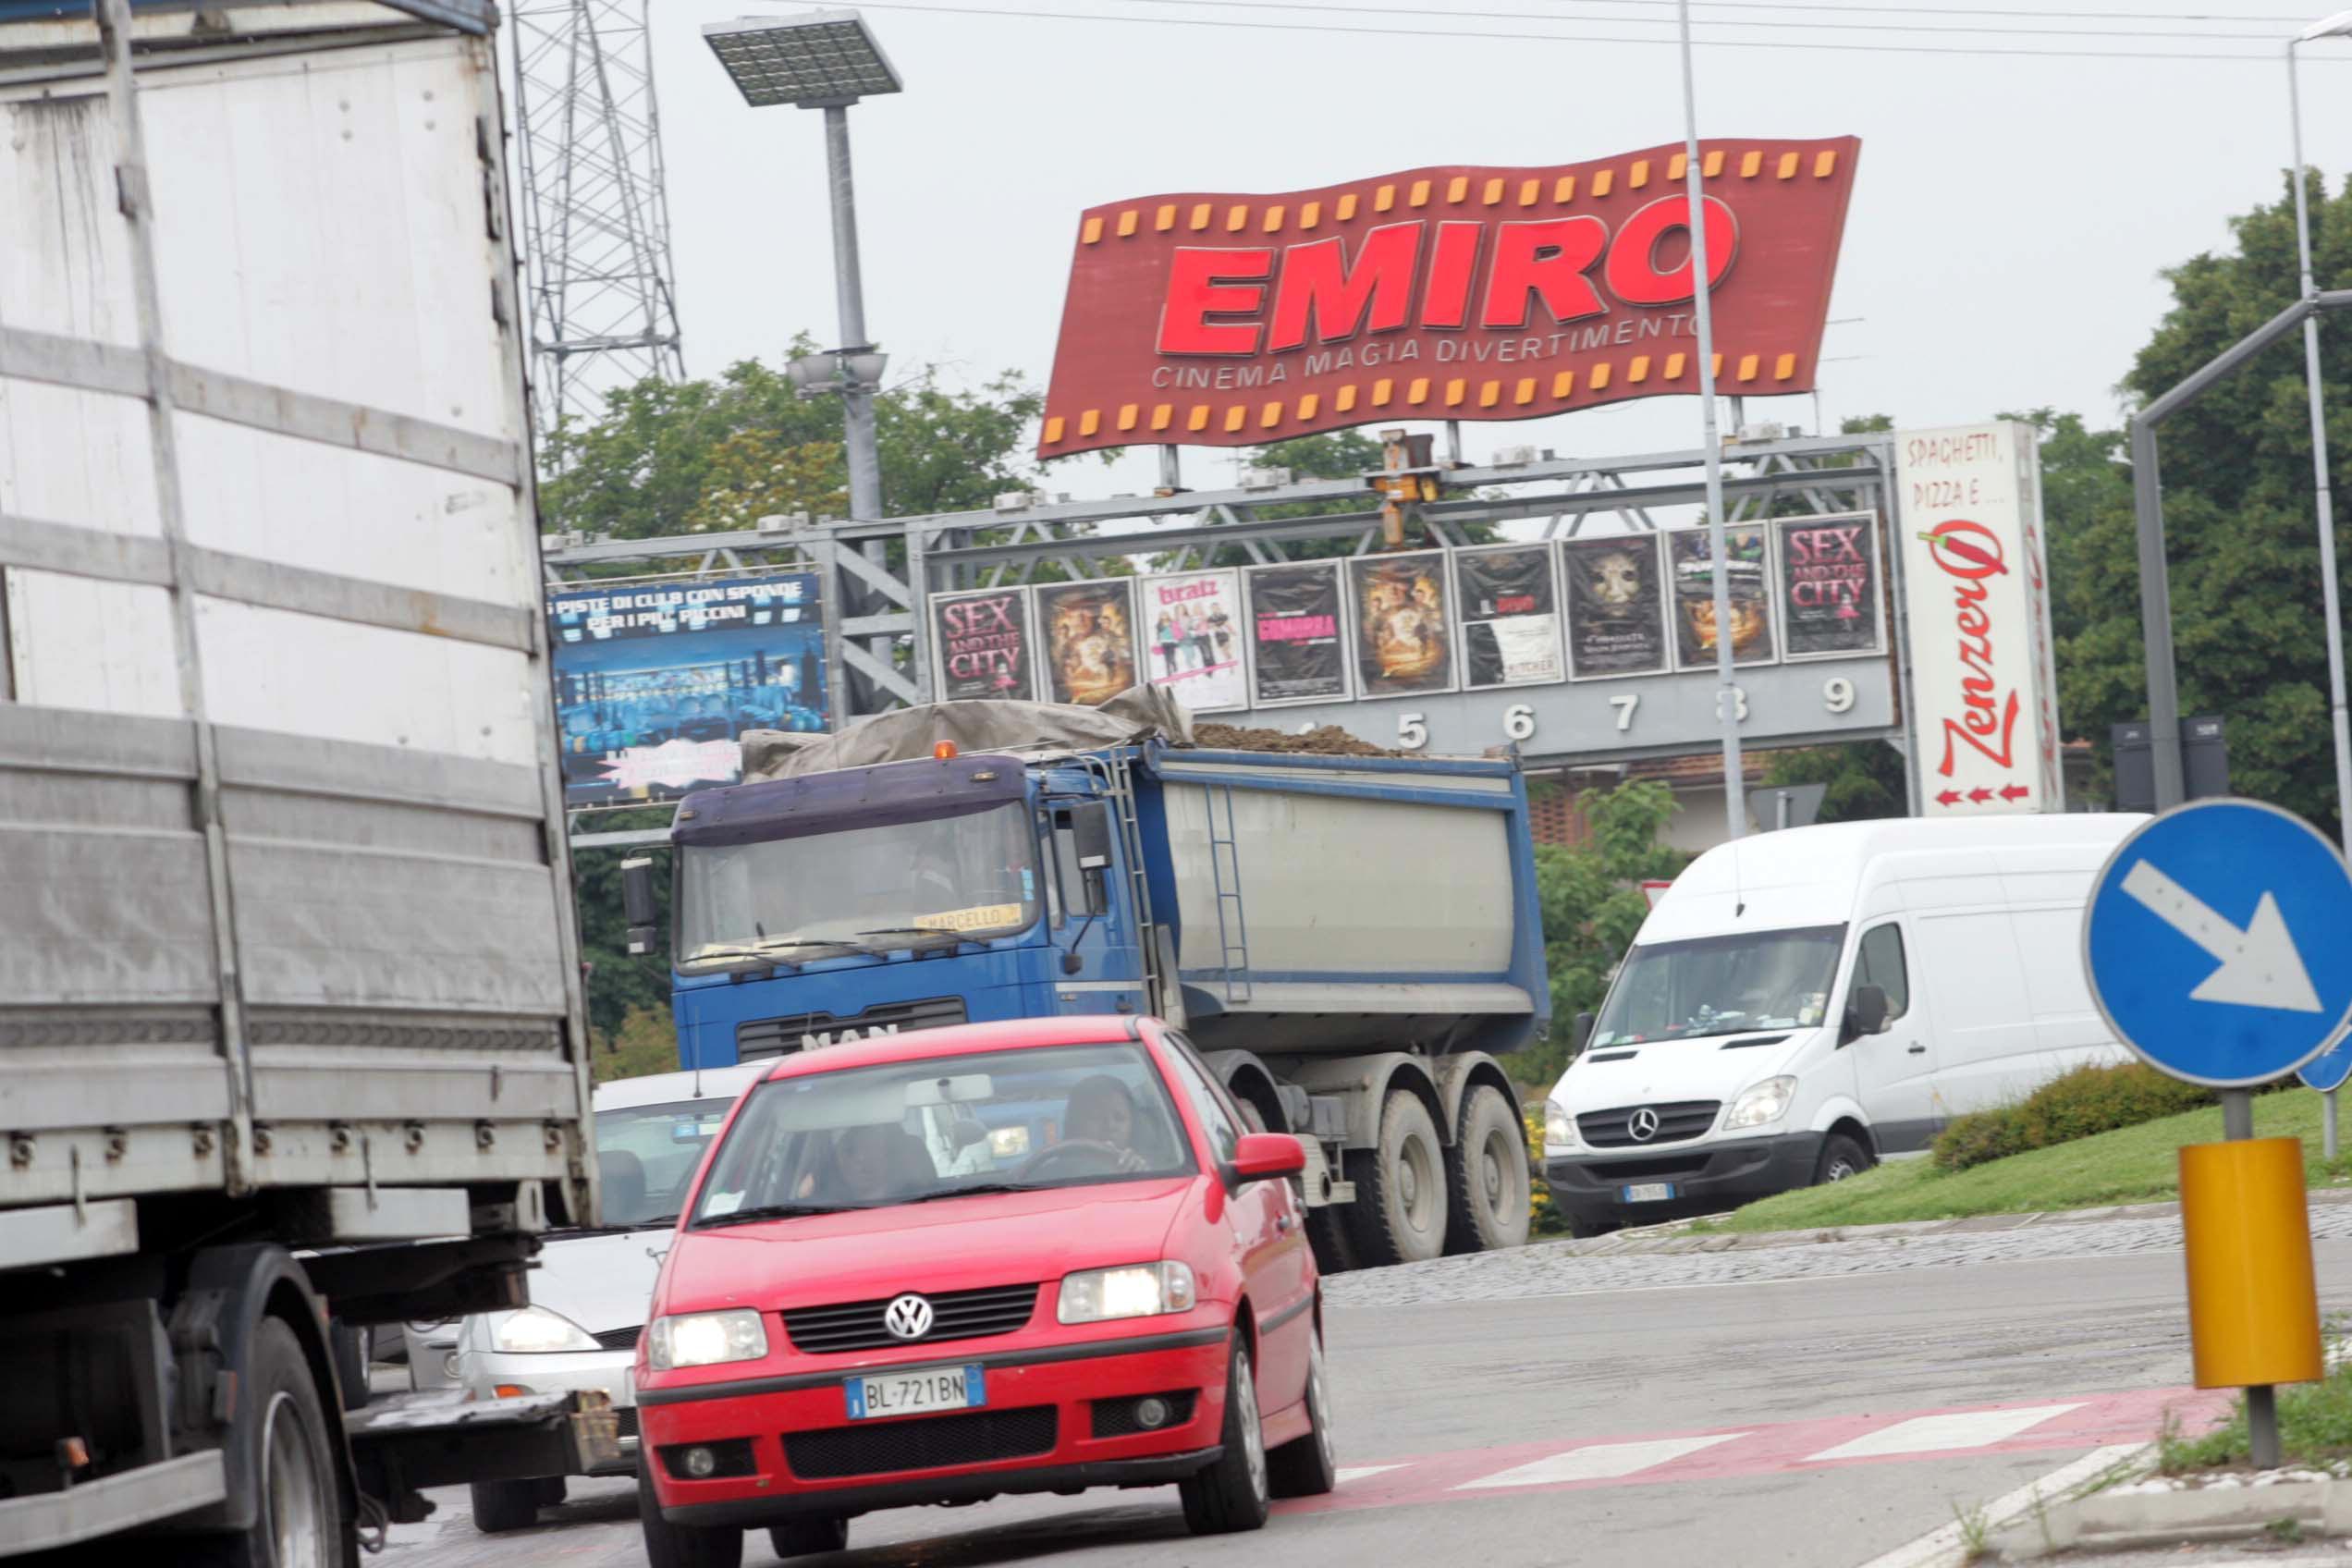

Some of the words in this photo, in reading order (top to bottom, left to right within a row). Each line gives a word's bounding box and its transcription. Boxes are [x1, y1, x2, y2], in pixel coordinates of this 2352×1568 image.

[1156, 193, 1739, 357] EMIRO
[1151, 362, 1288, 390] CINEMA
[1304, 338, 1420, 377] MAGIA
[1913, 480, 1963, 510] PIZZA
[1790, 527, 1865, 566] SEX
[557, 597, 609, 615] PISTE
[612, 595, 632, 610] DI
[685, 588, 726, 604] CON
[726, 582, 803, 600] SPONDE
[1790, 577, 1866, 607] CITY
[586, 614, 625, 631] PER
[944, 596, 1018, 640] SEX
[949, 646, 1020, 680] CITY
[1609, 694, 1639, 730] 7
[1823, 677, 1856, 713] 9
[1398, 712, 1428, 750] 5
[1502, 704, 1535, 741] 6
